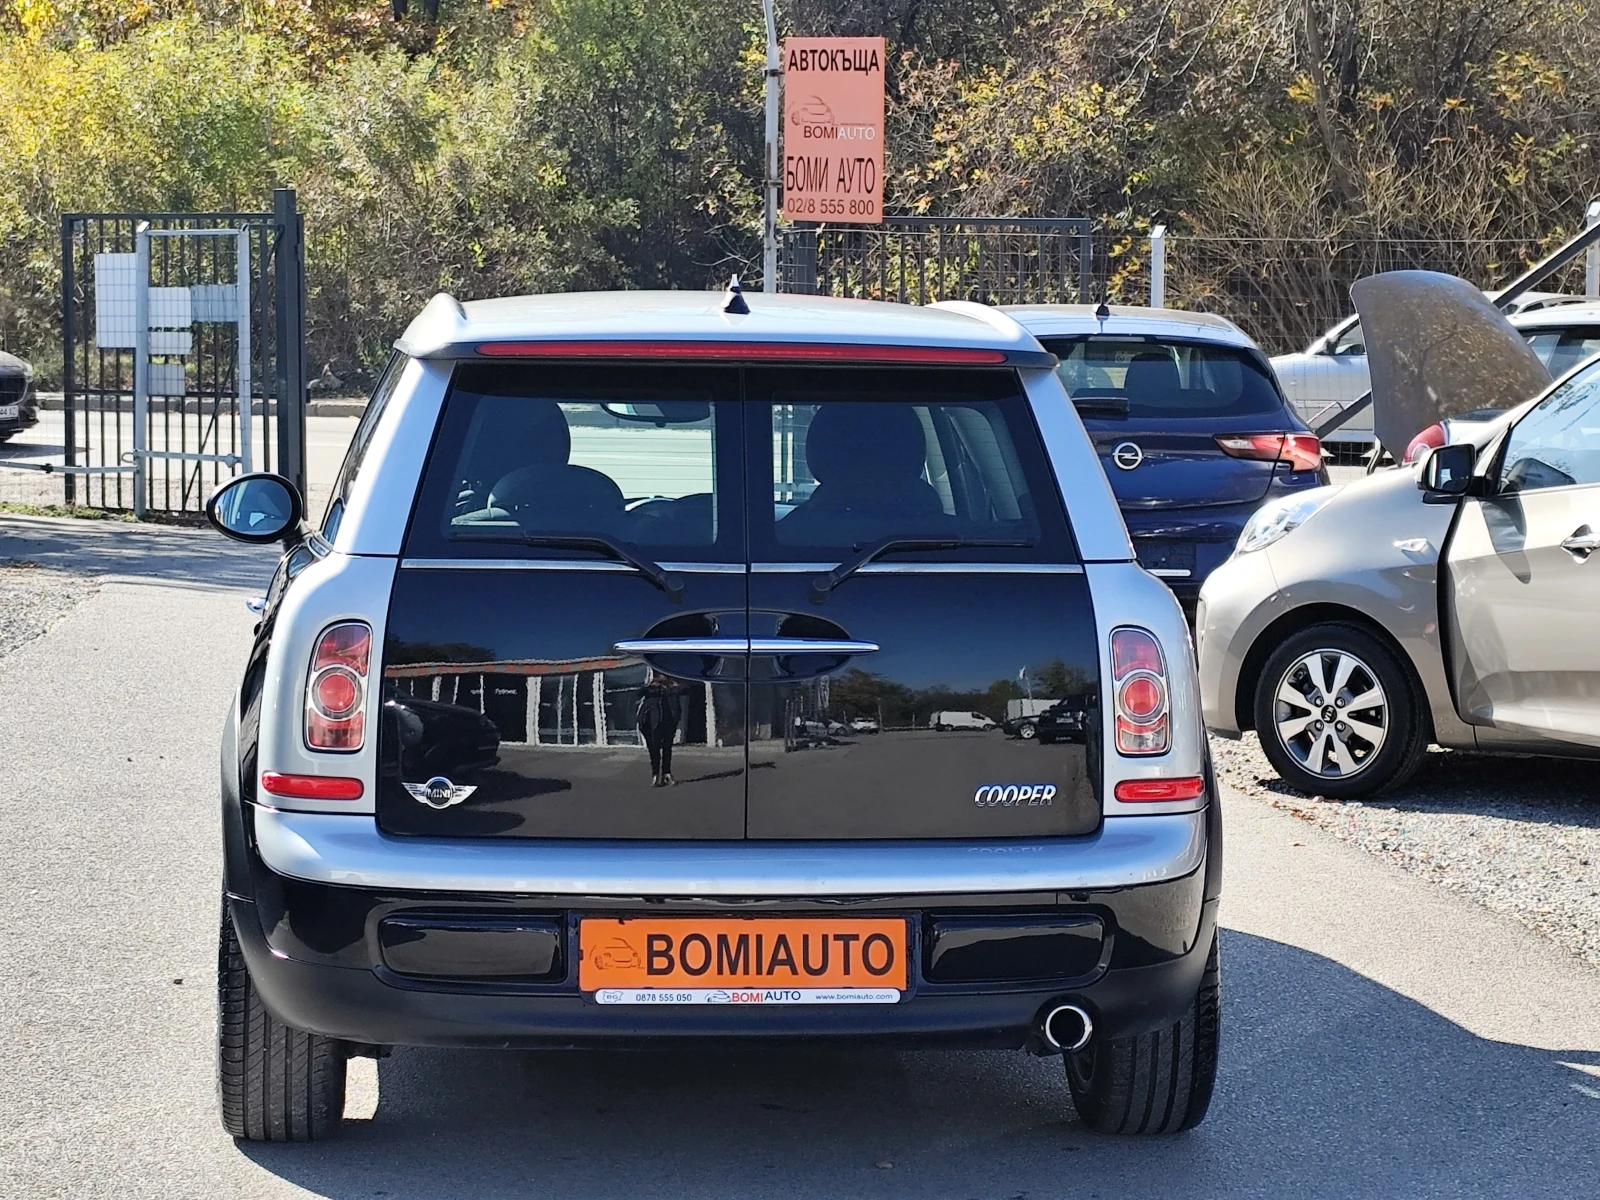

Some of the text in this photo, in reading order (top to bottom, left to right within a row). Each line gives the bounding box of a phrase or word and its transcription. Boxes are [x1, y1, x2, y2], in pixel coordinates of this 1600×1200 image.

[788, 49, 880, 76] АВТОКЪЩА
[803, 125, 876, 140] BOMIAUTO
[786, 155, 876, 194] БОМИ АУТО
[787, 197, 875, 215] 02/8 555 800
[427, 788, 451, 799] MINI
[974, 784, 1057, 807] COOPER
[646, 933, 895, 976] BOMIAUTO
[635, 993, 692, 1002] 0878 555 050
[732, 991, 802, 1002] BOMIAUTO
